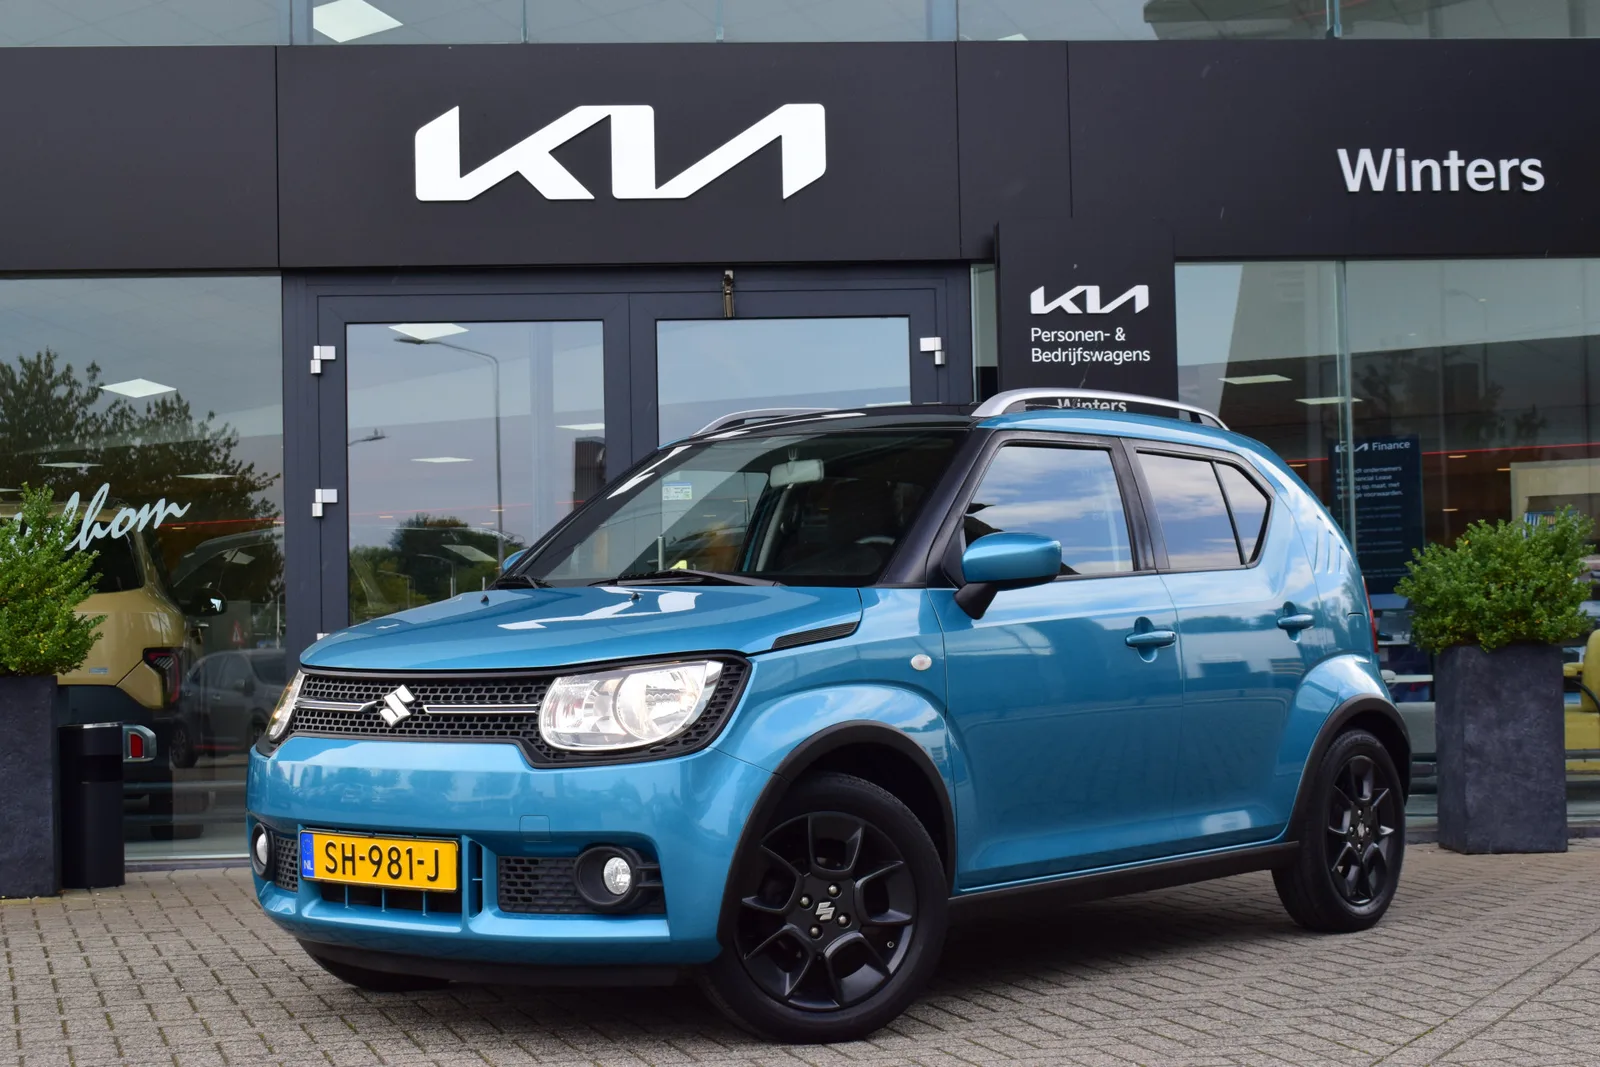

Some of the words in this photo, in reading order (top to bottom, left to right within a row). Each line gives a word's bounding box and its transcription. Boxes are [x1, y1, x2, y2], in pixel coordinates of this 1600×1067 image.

[415, 103, 826, 201] KIA
[1337, 148, 1545, 192] Winters
[1030, 285, 1149, 315] KIA
[1031, 328, 1110, 342] Personen-
[1115, 327, 1126, 342] &
[1032, 347, 1151, 366] Bedrijfswagens
[1372, 441, 1411, 451] Finance
[304, 860, 313, 871] NL
[325, 841, 439, 882] SH-981-J
